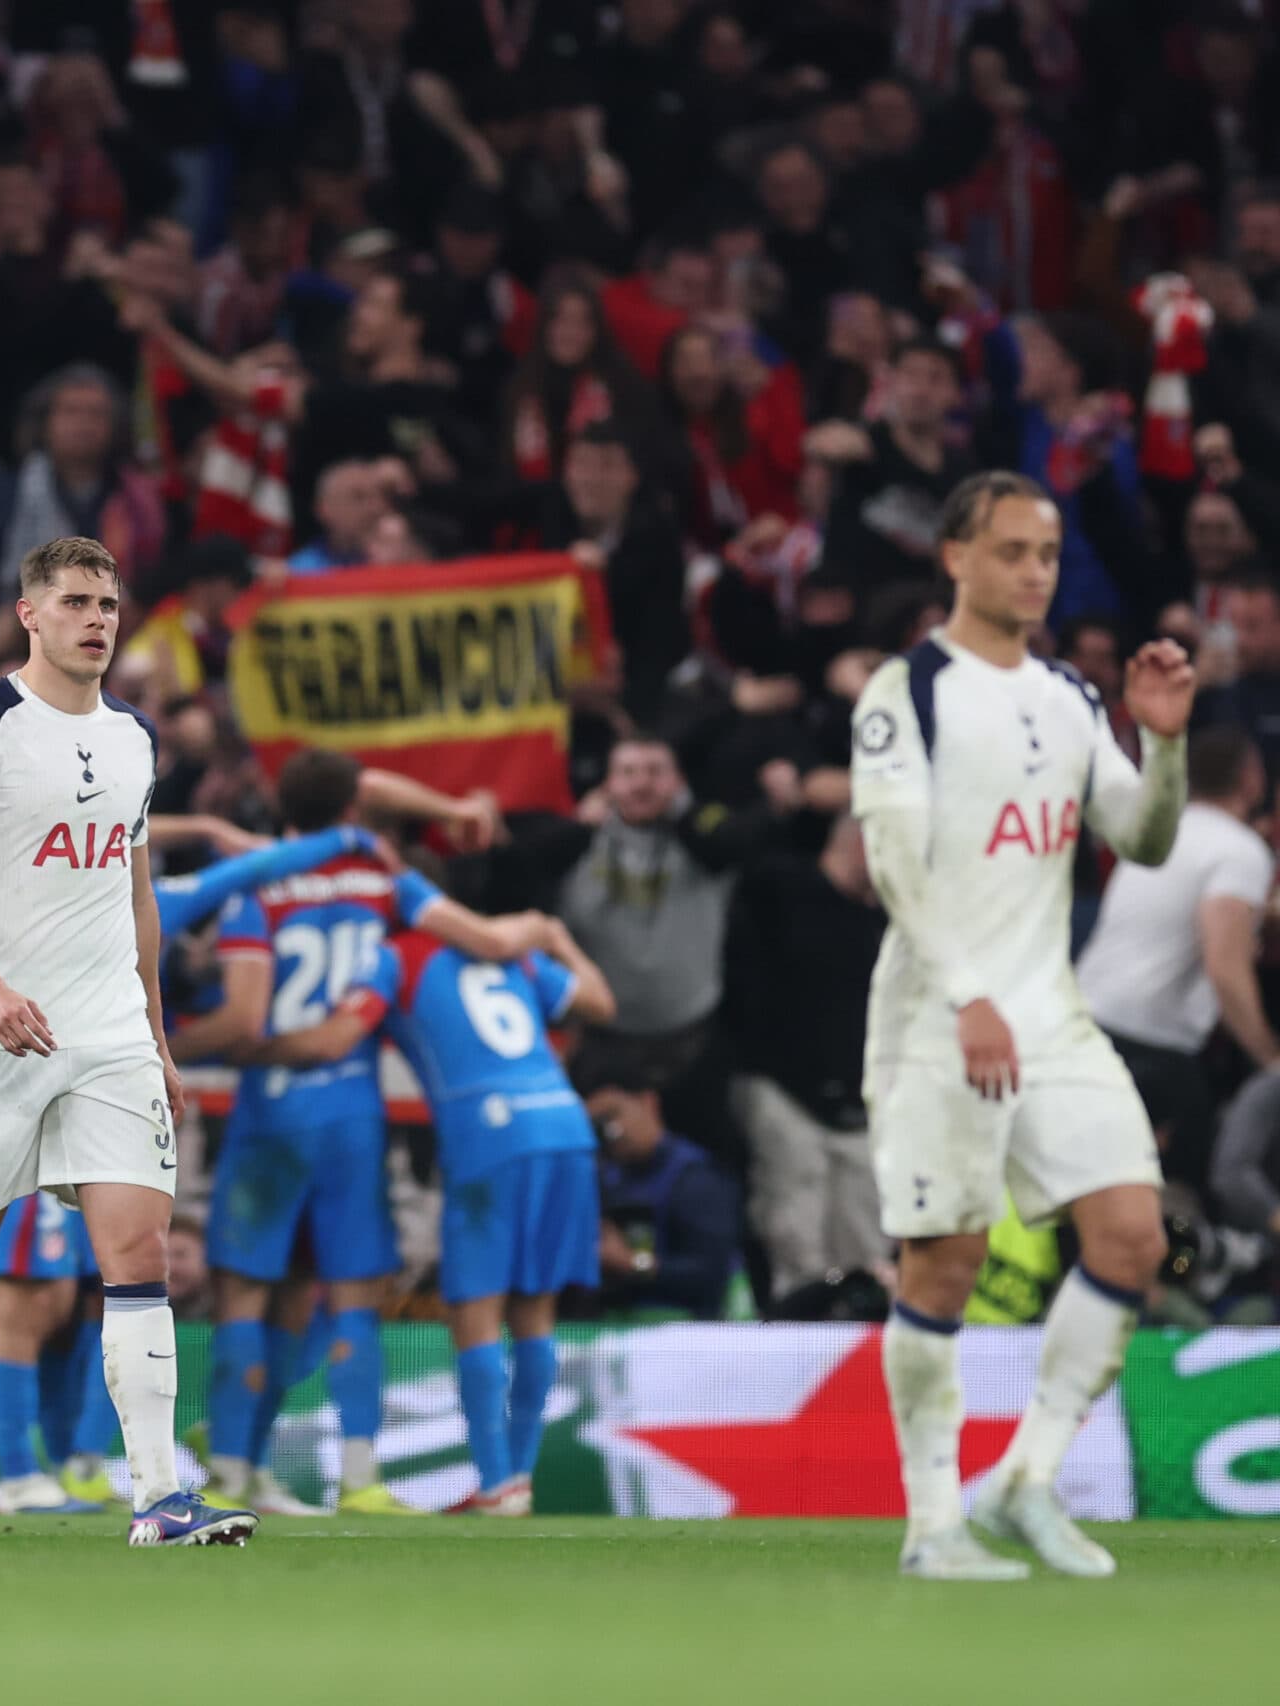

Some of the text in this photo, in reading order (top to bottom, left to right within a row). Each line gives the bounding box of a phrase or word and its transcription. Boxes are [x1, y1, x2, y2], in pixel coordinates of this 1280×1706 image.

[33, 822, 127, 870] AIA
[985, 799, 1081, 857] AIA
[459, 962, 535, 1060] 6
